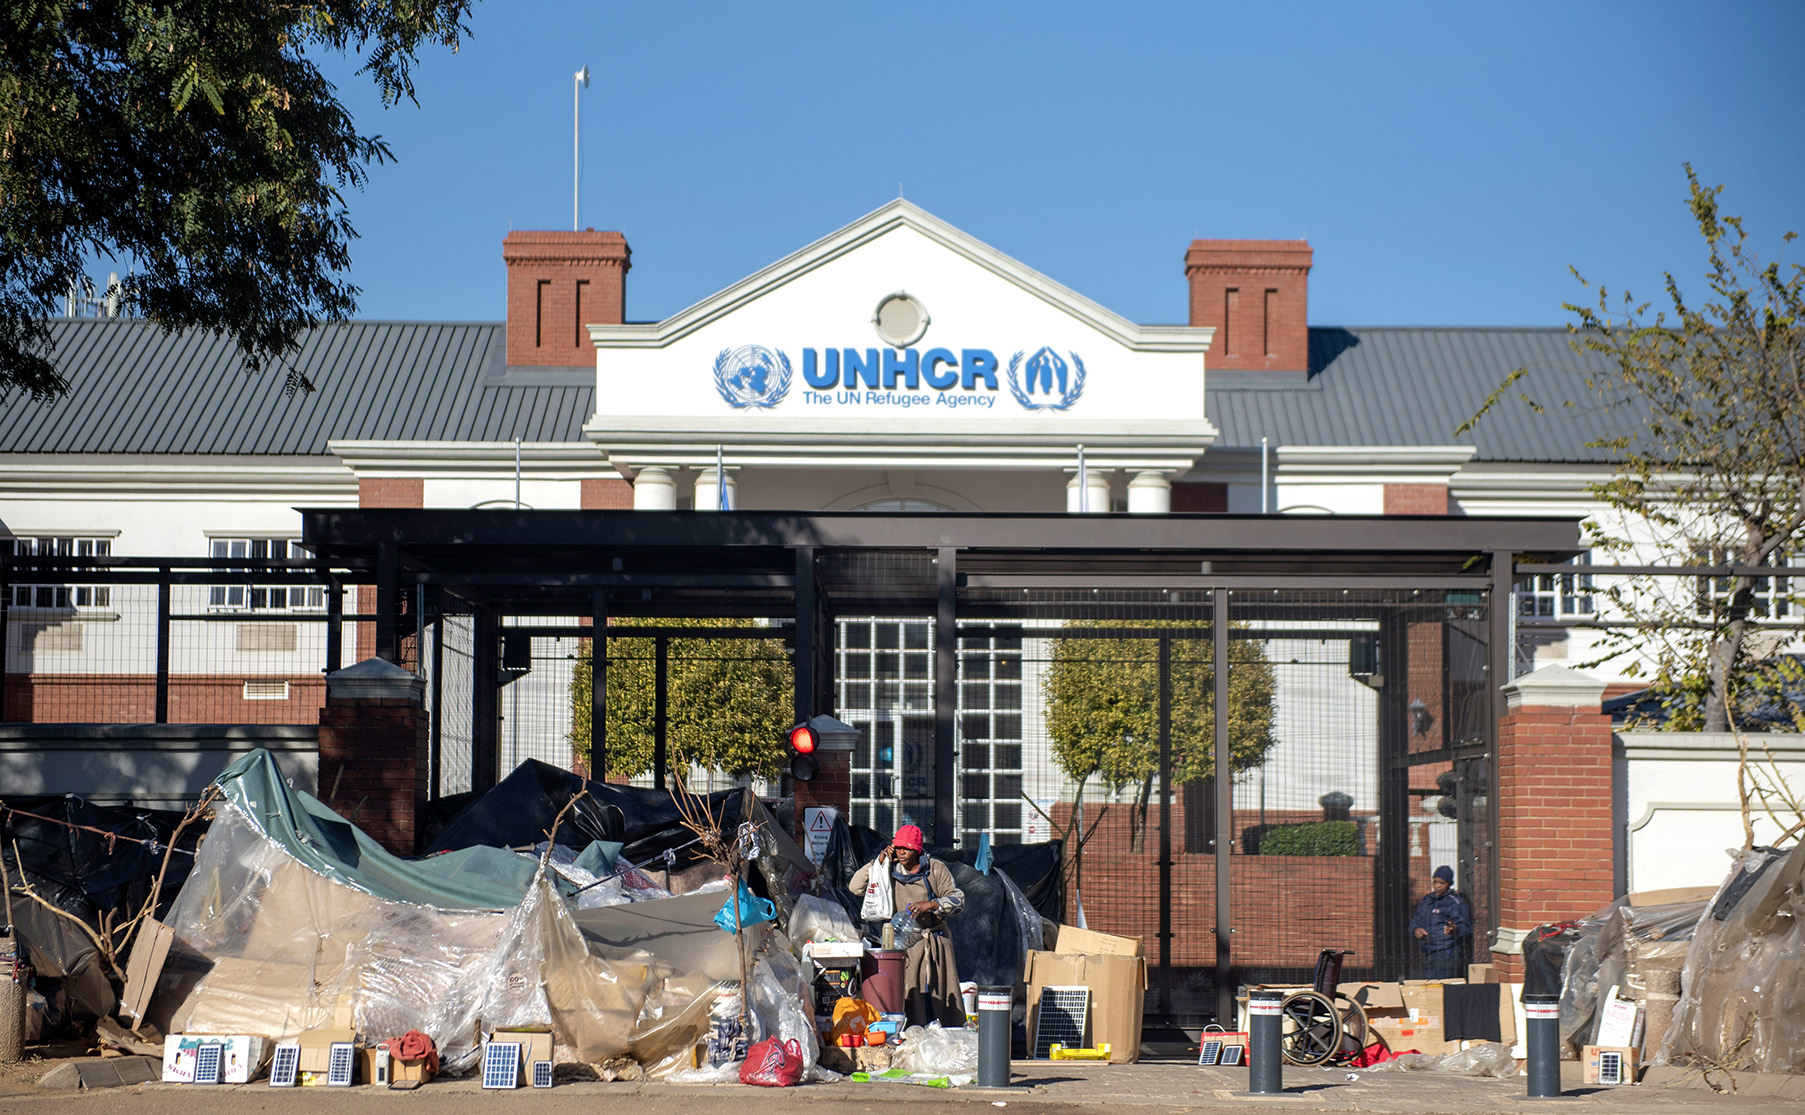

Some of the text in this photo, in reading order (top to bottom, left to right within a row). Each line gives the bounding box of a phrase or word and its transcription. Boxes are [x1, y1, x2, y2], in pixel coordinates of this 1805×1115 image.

[803, 347, 999, 391] UNHCR
[802, 391, 995, 409] The UN Refugee Agency
